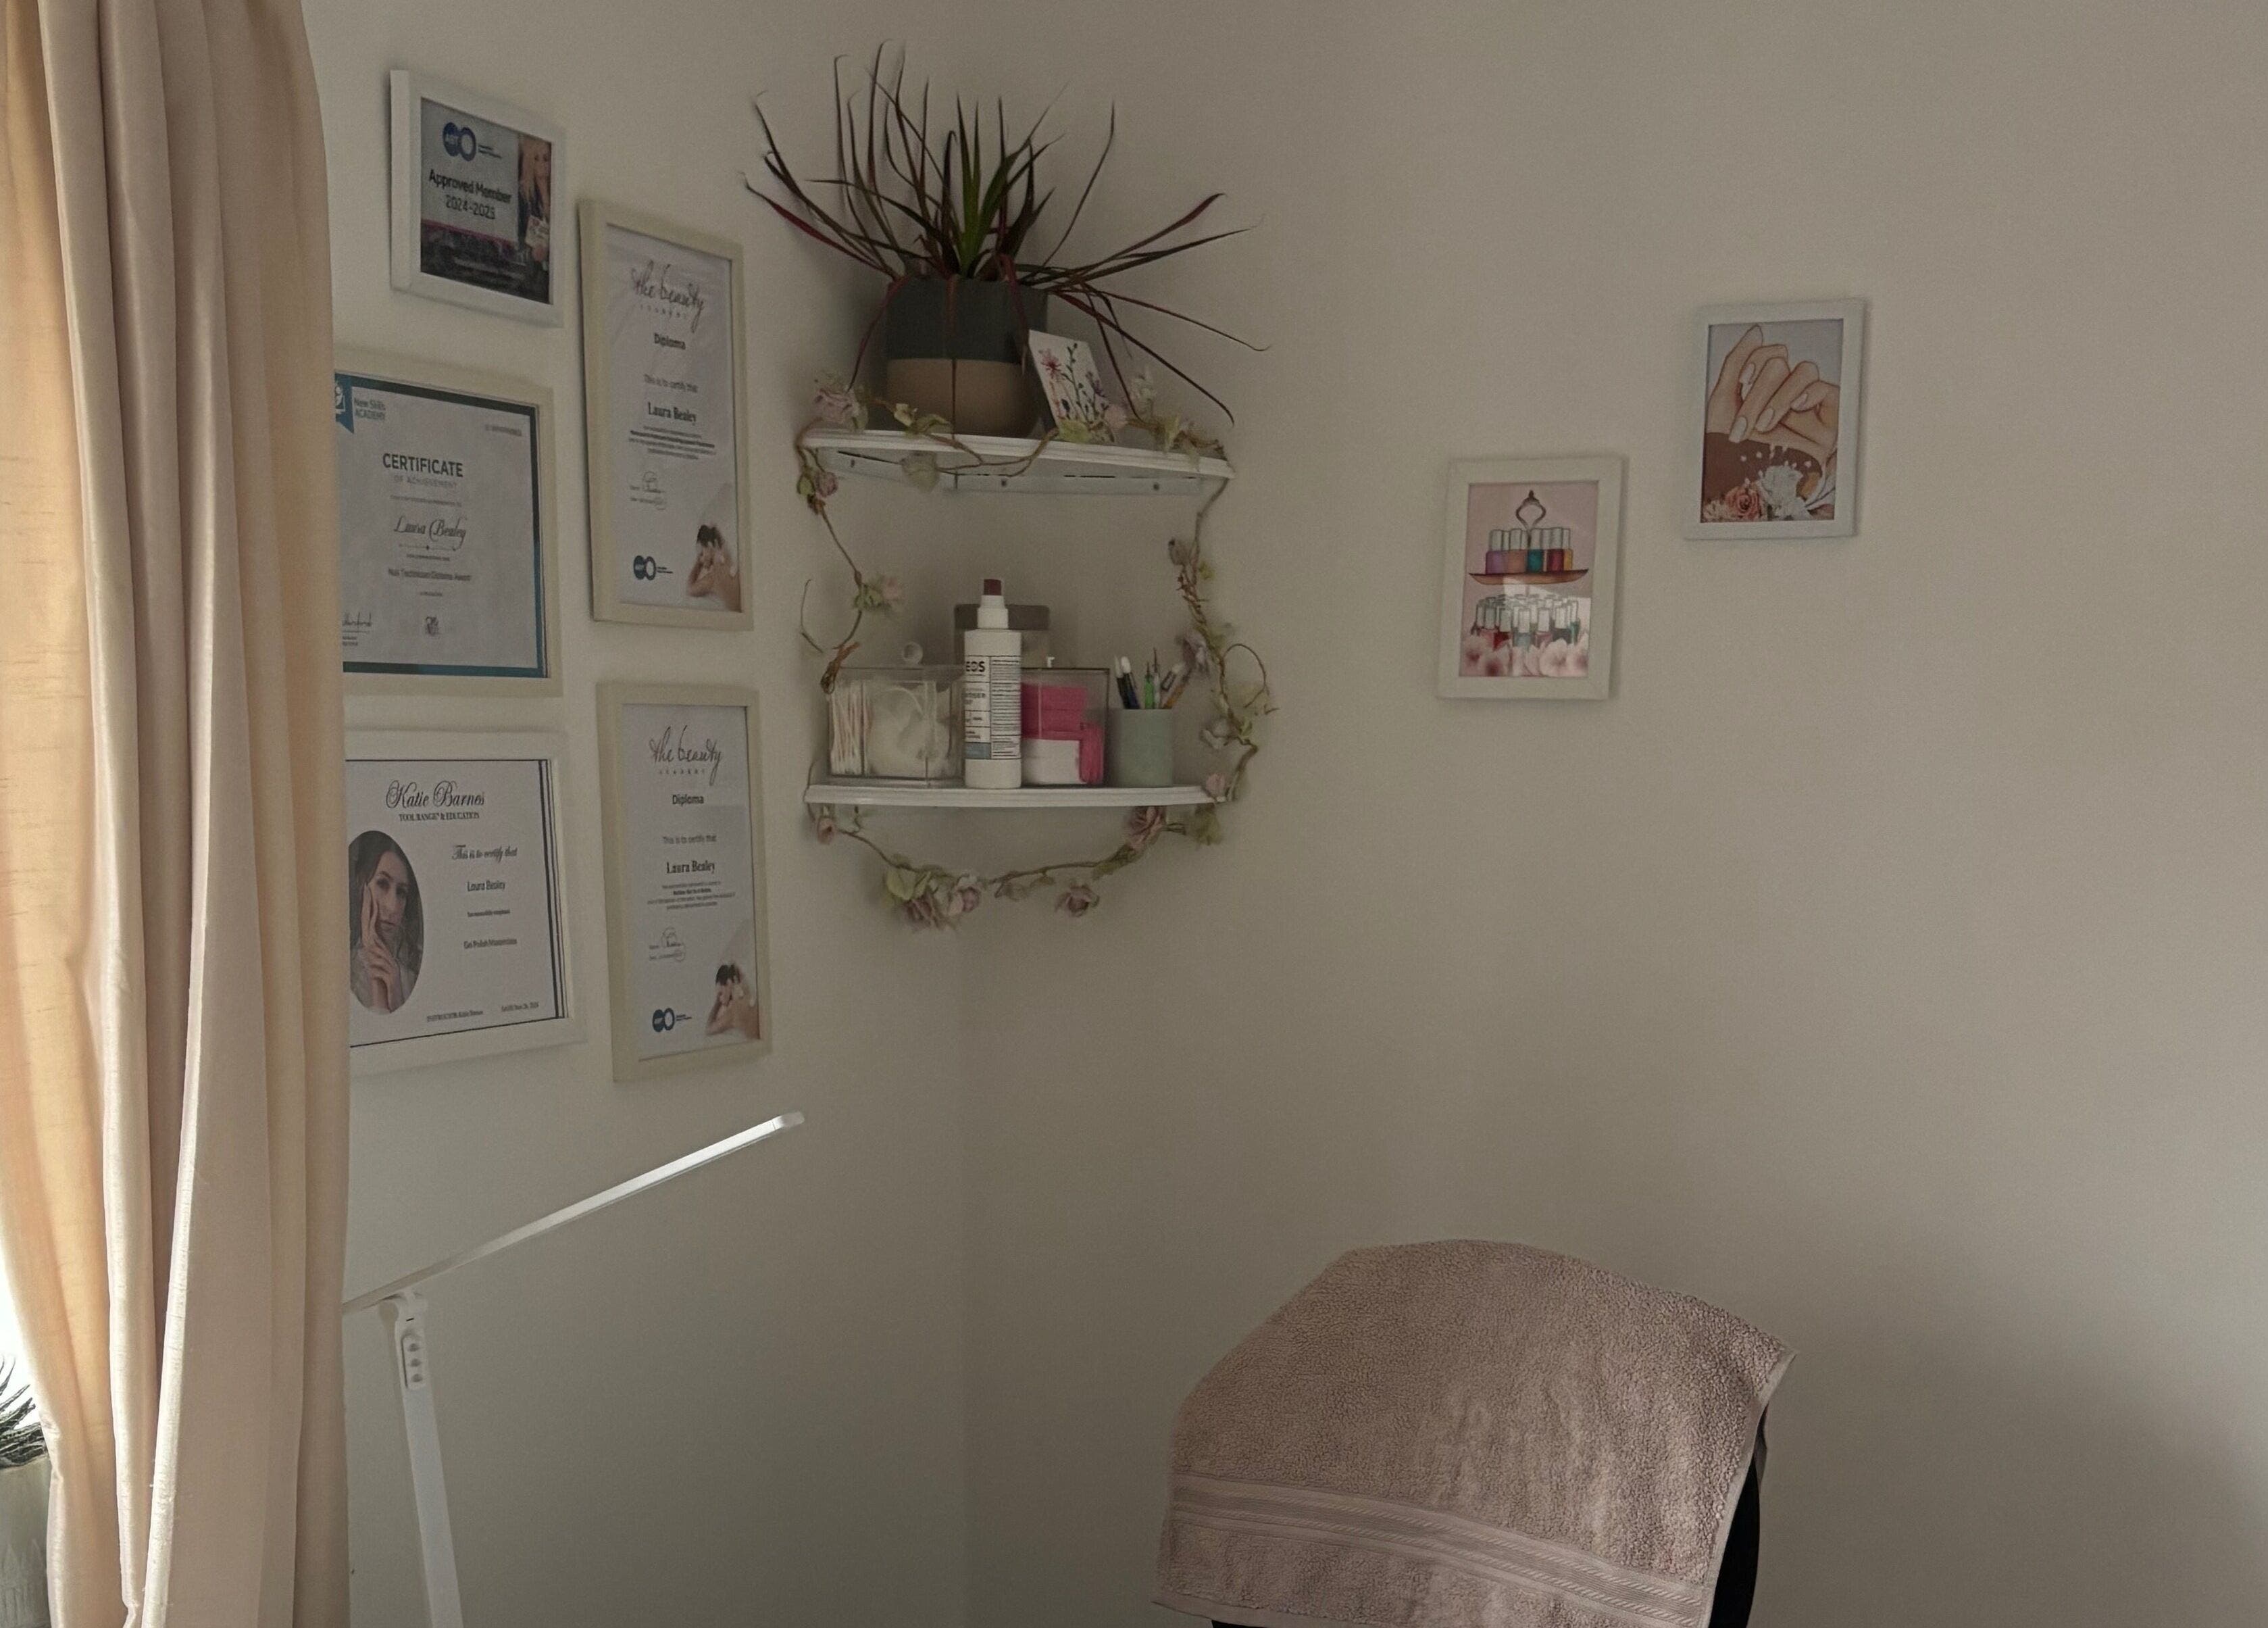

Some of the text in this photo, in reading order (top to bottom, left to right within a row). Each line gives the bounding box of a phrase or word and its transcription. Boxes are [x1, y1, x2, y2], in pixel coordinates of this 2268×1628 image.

[429, 168, 512, 205] Approved Member
[654, 332, 686, 351] Diploma
[648, 401, 672, 419] Laura
[382, 453, 464, 478] CERTIFICATE
[393, 515, 427, 535] Laura
[386, 780, 485, 809] Katie Barnes
[672, 793, 705, 807] Diploma
[666, 862, 690, 874] Laura
[467, 881, 485, 892] Laura
